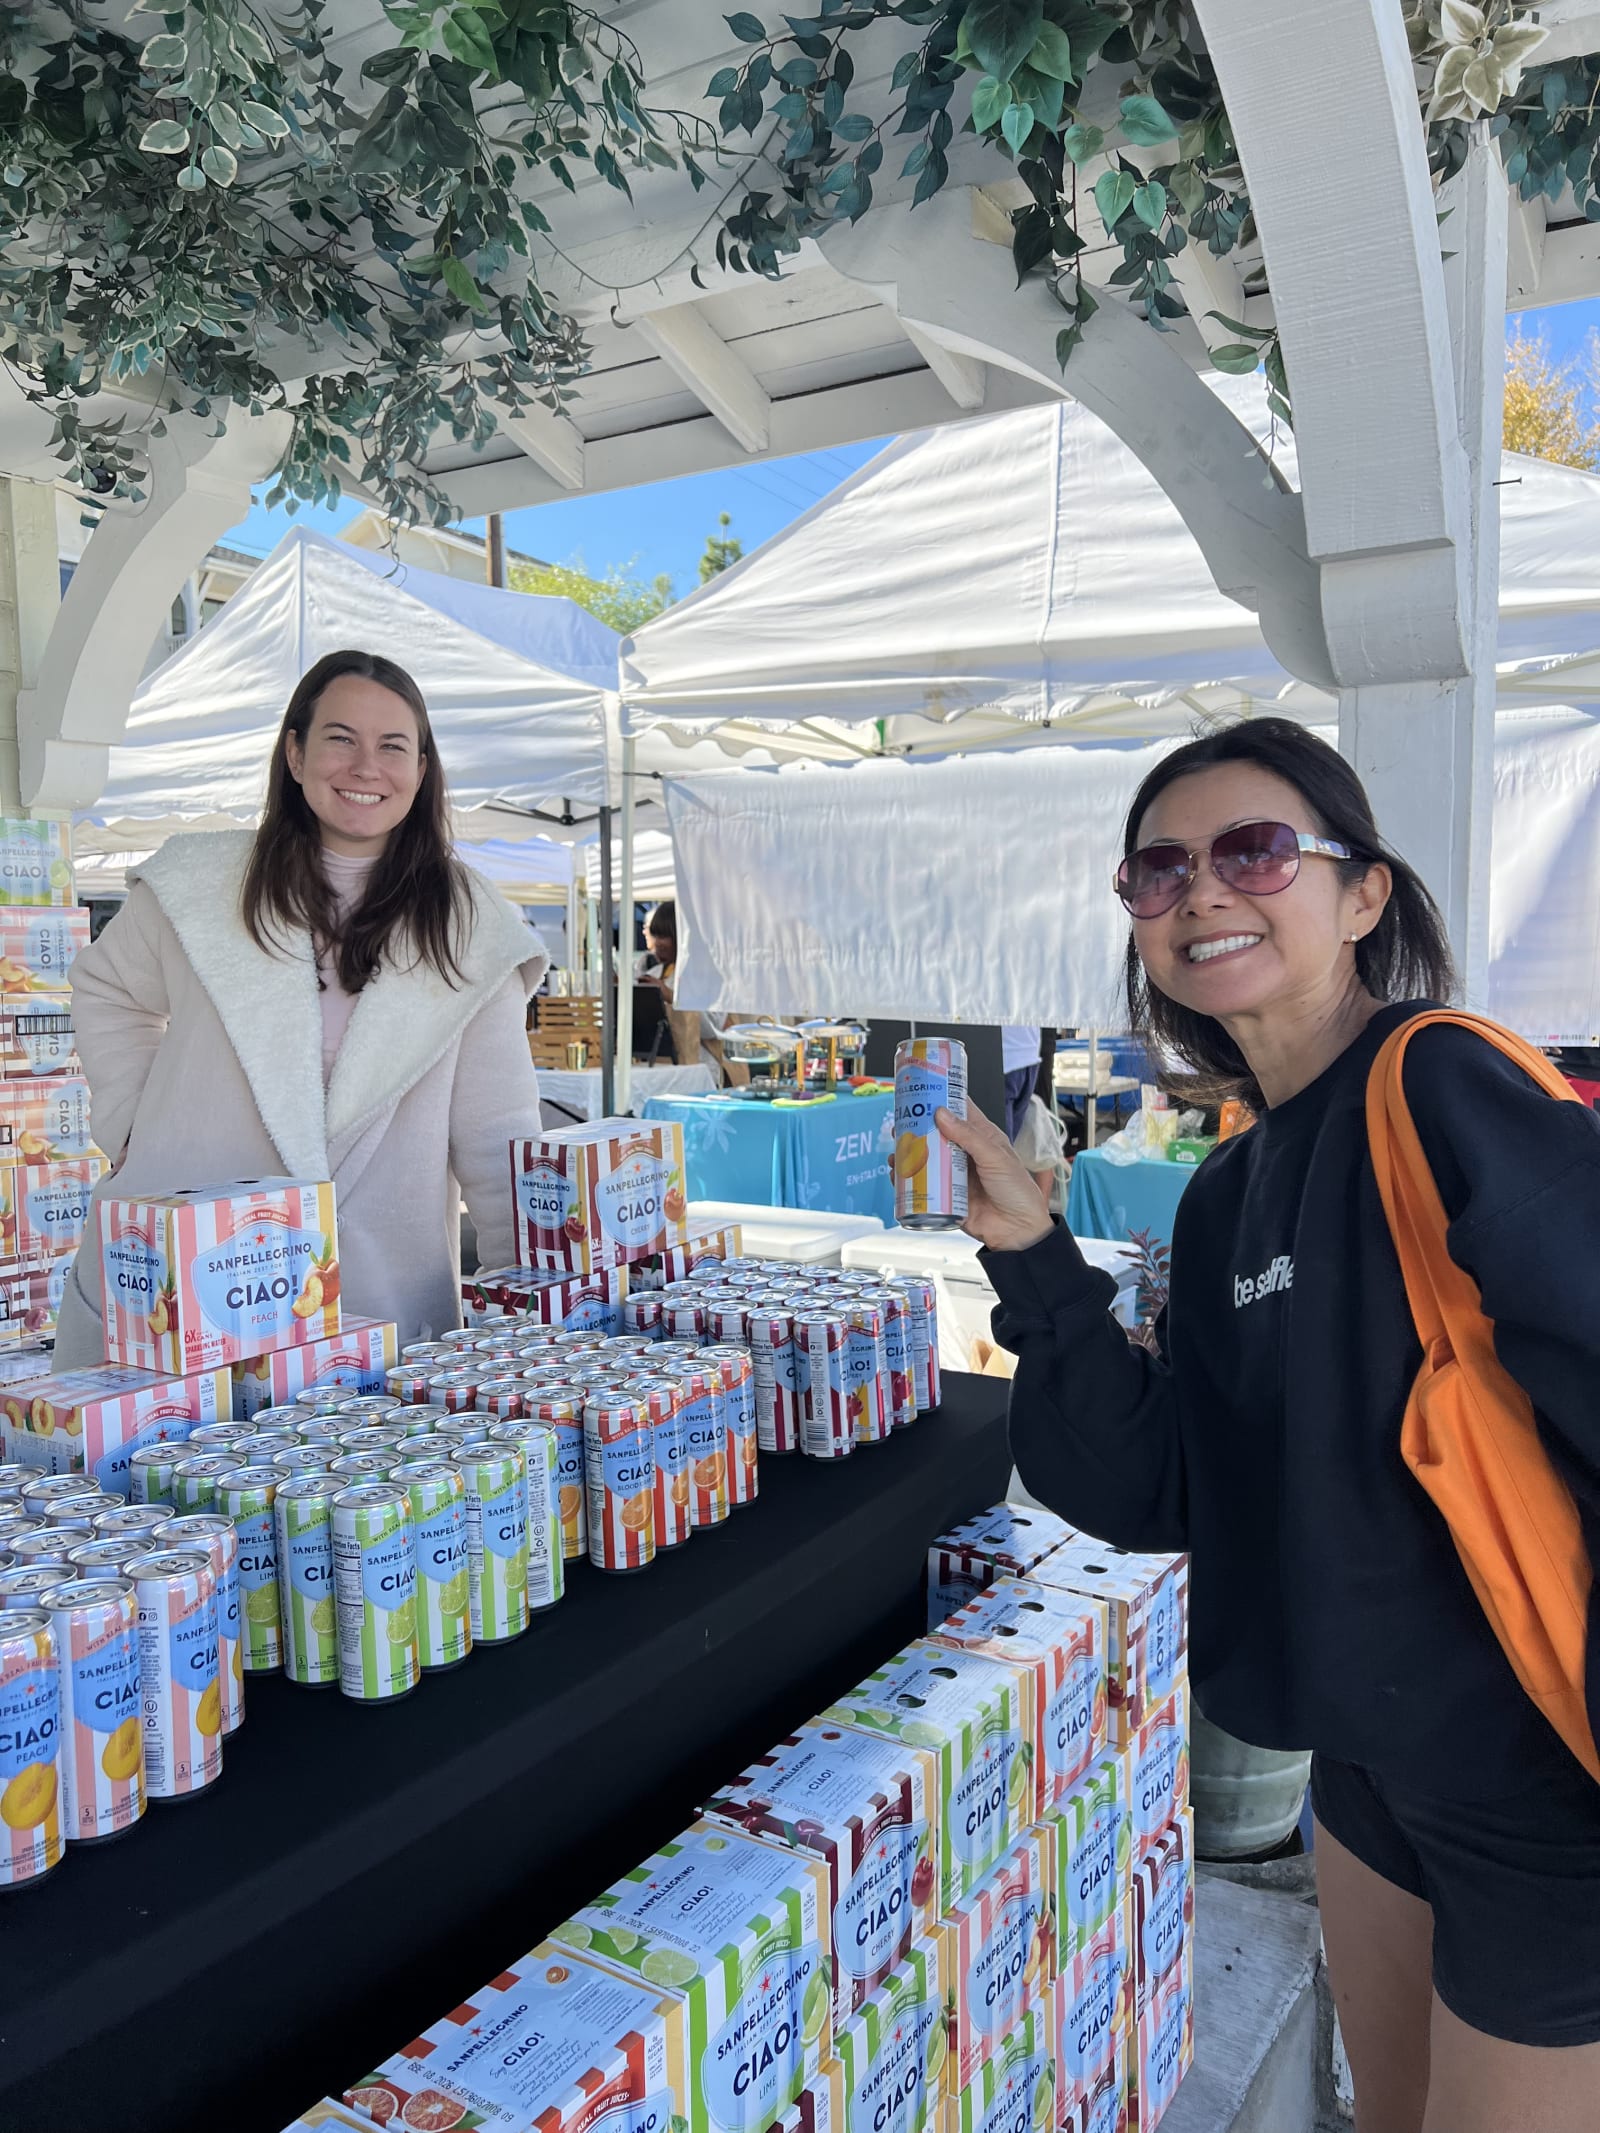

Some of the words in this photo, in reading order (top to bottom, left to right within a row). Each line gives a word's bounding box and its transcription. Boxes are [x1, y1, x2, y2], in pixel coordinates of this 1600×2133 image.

[2, 865, 48, 878] CIAO!
[40, 928, 52, 970] CIAO!
[59, 1099, 71, 1140] CIAO!
[835, 1130, 873, 1162] ZEN
[522, 1180, 570, 1192] SANPELLEGRINO
[605, 1170, 669, 1195] SANPELLEGRINO
[44, 1206, 88, 1222] CIAO!
[257, 1211, 272, 1219] FRUIT
[529, 1197, 563, 1213] CIAO!
[617, 1195, 661, 1223] CIAO!
[110, 1250, 160, 1267] SANPELLEGRINO
[208, 1242, 312, 1273] SANPELLEGRINO
[117, 1272, 153, 1294] CIAO!
[226, 1275, 299, 1309] CIAO!
[1234, 1274, 1254, 1308] be
[251, 1311, 278, 1324] PEACH
[184, 1329, 196, 1344] 6X
[159, 1408, 173, 1416] FRUIT
[689, 1424, 725, 1444] CIAO!
[617, 1482, 638, 1491] BLOOD
[245, 1508, 260, 1519] REAL
[297, 1521, 311, 1533] WITH
[427, 1507, 441, 1517] WITH
[373, 1531, 389, 1542] WITH
[400, 1586, 413, 1598] LIME
[1156, 1608, 1165, 1677] CIAO!
[1050, 1667, 1099, 1720] SANPELLEGRINO
[0, 1713, 58, 1753] CIAO!
[1057, 1701, 1092, 1749] CIAO!
[16, 1744, 48, 1764] PEACH
[180, 1763, 185, 1773] 5
[1135, 1735, 1181, 1785] SANPELLEGRINO
[767, 1752, 816, 1793] SANPELLEGRINO
[808, 1769, 836, 1791] CIAO!
[957, 1742, 1015, 1805] SANPELLEGRINO
[1142, 1767, 1175, 1811] CIAO!
[85, 1808, 90, 1817] 5
[965, 1779, 1007, 1837] CIAO!
[870, 1826, 881, 1838] REAL
[1072, 1813, 1121, 1873] SANPELLEGRINO
[845, 1835, 919, 1914] SANPELLEGRINO
[1080, 1847, 1115, 1901] CIAO!
[633, 1865, 695, 1917] SANPELLEGRINO
[681, 1884, 715, 1912] CIAO!
[855, 1879, 909, 1947] CIAO!
[1156, 1901, 1183, 1953] CIAO!
[763, 1943, 776, 1958] FRUIT
[871, 1928, 896, 1957] CHERRY
[976, 1904, 1036, 1978] SANPELLEGRINO
[985, 1944, 1027, 2007] CIAO!
[717, 1960, 811, 2061] SANPELLEGRINO
[747, 1996, 758, 2008] DAL
[1070, 1961, 1121, 2029] SANPELLEGRINO
[447, 2004, 529, 2072] SANPELLEGRINO
[1078, 1998, 1114, 2054] CIAO!
[503, 2031, 545, 2067] CIAO!
[647, 2046, 664, 2061] SUGAR
[733, 2010, 799, 2096] CIAO!
[862, 2012, 933, 2103] SANPELLEGRINO
[1156, 2031, 1182, 2085] CIAO!
[759, 2075, 777, 2100] LIME
[873, 2056, 924, 2132] CIAO!
[500, 2111, 515, 2123] 09
[576, 2114, 593, 2132] REAL
[593, 2098, 610, 2116] FRUIT
